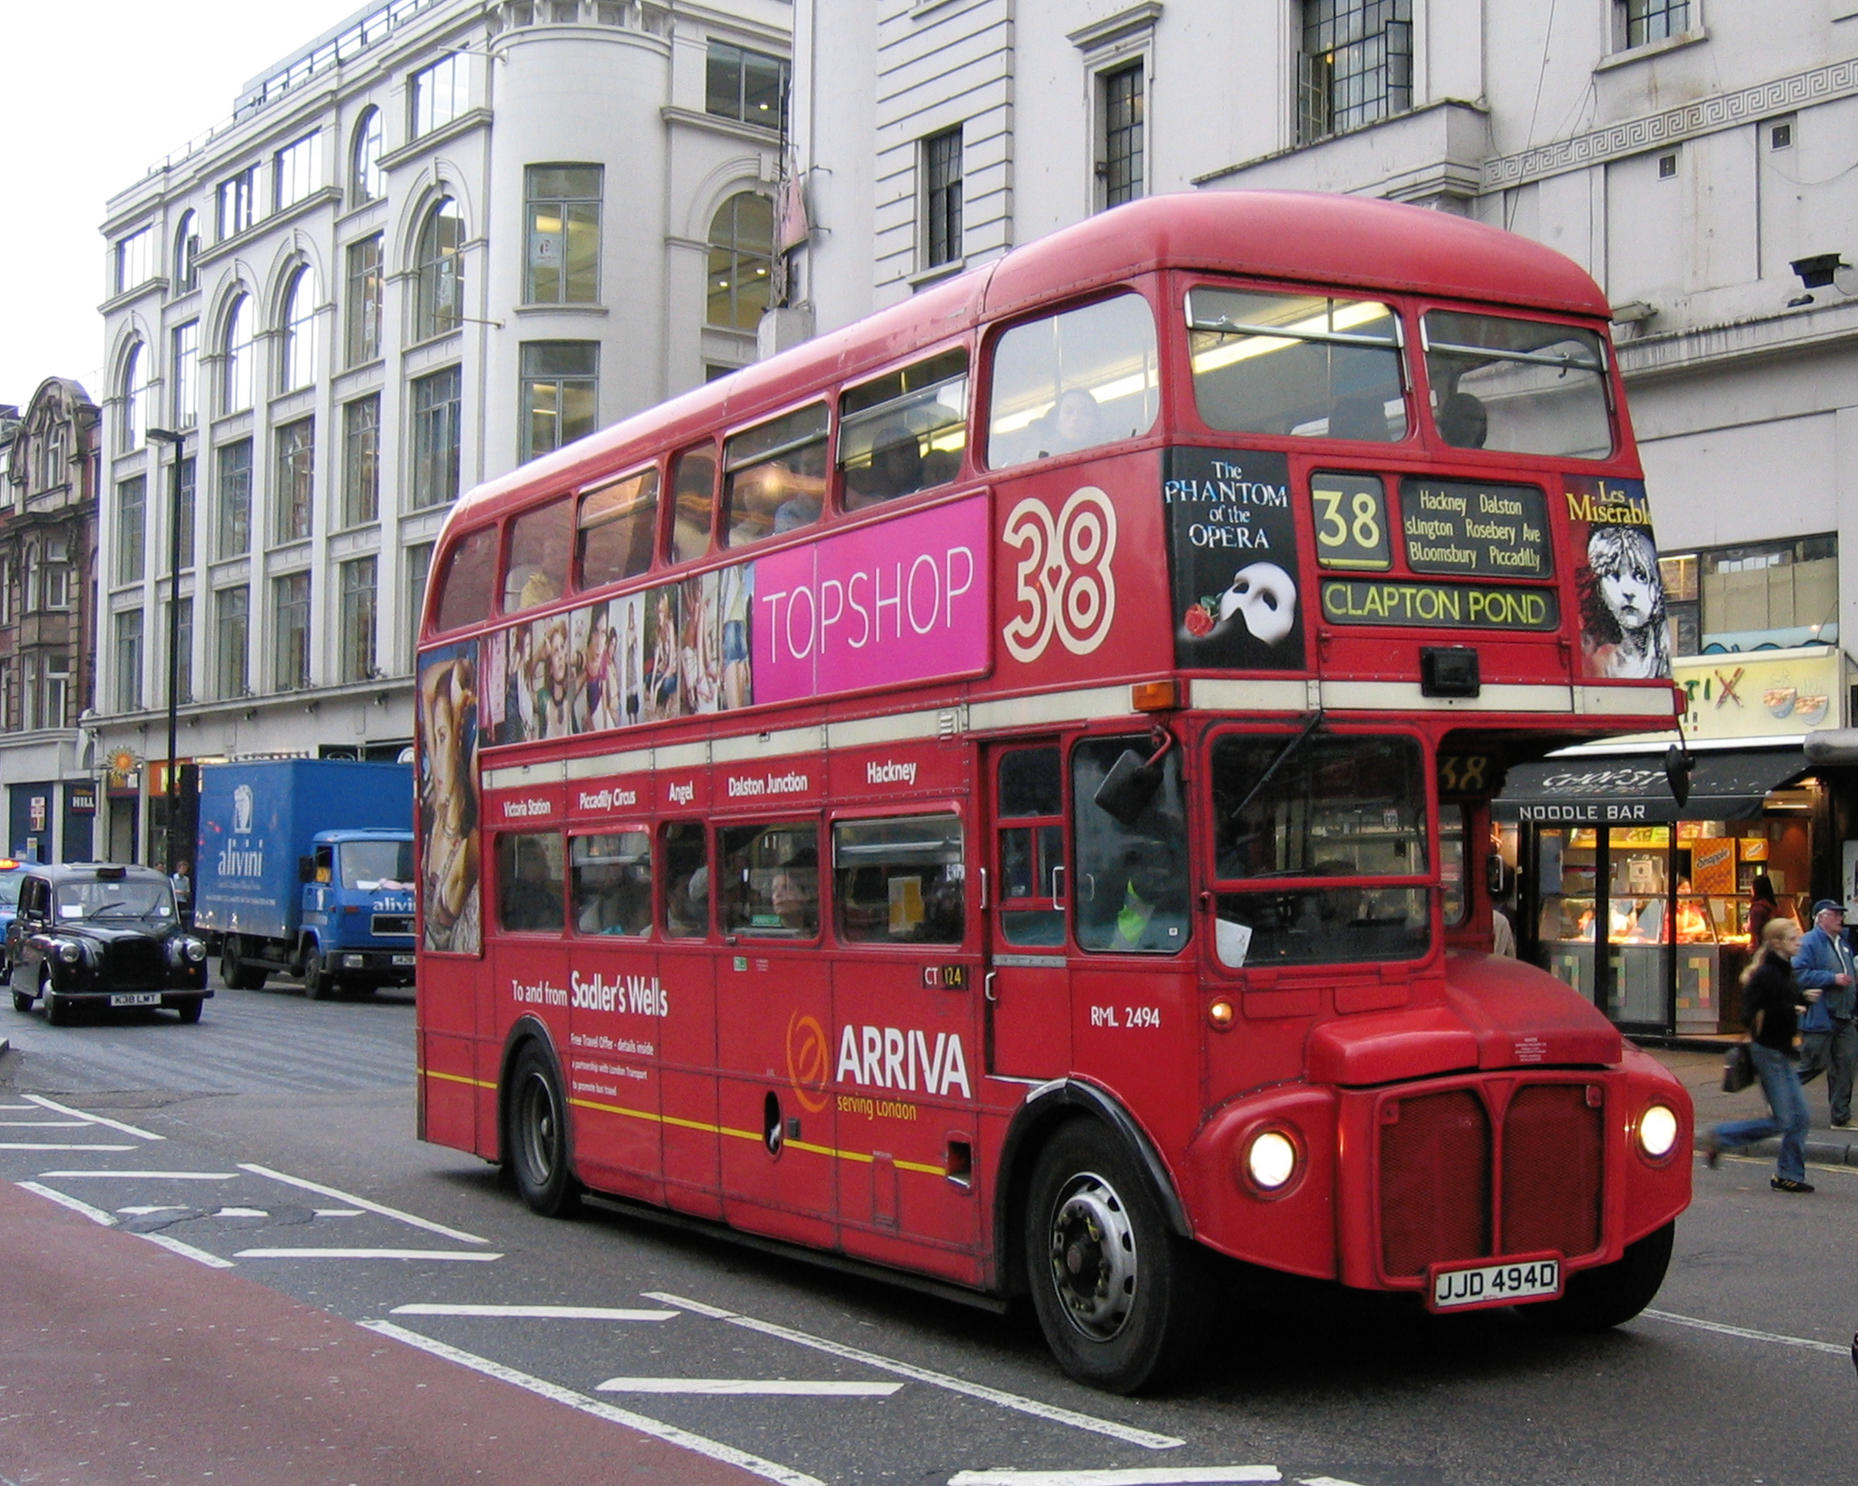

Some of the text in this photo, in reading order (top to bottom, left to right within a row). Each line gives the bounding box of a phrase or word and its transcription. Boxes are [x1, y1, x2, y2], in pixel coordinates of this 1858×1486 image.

[1211, 460, 1242, 479] The
[1164, 480, 1288, 507] PHANTOM
[1419, 489, 1522, 517] Hackney Dalston
[1597, 480, 1625, 503] Les
[1209, 504, 1251, 523] of the
[1312, 490, 1380, 548] 38
[1189, 523, 1270, 549] OPERA
[1405, 515, 1541, 546] slington Rosebery Ave
[1409, 541, 1540, 572] Bloomsbury Piccadilly
[1002, 486, 1117, 663] 38
[762, 546, 974, 664] TOPSHOP
[1325, 583, 1546, 625] CLAPTON POND
[728, 771, 808, 797] Dalston Junction
[867, 760, 917, 785] Hackney
[579, 787, 636, 811] Piccadilly Circus
[668, 780, 694, 805] Angel
[503, 799, 551, 817] Victoria Station
[1519, 805, 1645, 820] NOODLE BAR
[218, 838, 263, 877] alivini
[924, 967, 938, 985] CT
[512, 970, 669, 1017] To and from Sadler's Wells
[1090, 1006, 1160, 1028] RML 2494
[836, 1024, 972, 1099] ARRIVA
[837, 1093, 917, 1121] serving London
[1438, 1263, 1555, 1300] JJD 494D
